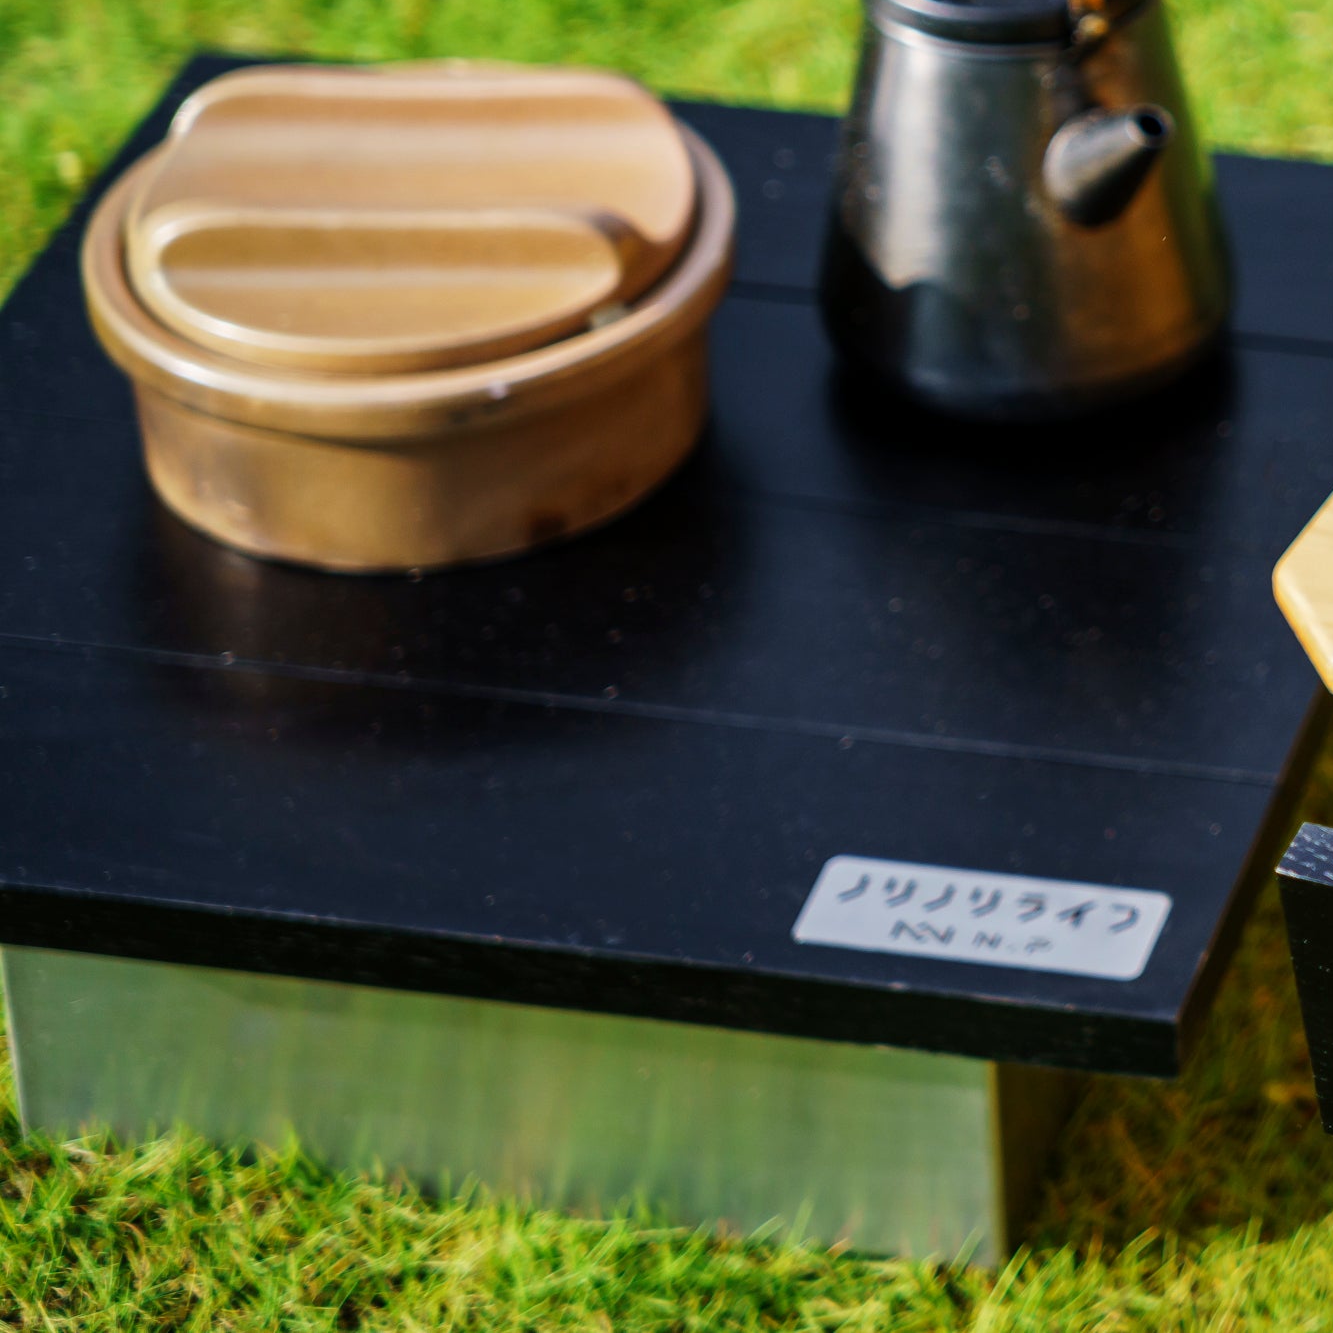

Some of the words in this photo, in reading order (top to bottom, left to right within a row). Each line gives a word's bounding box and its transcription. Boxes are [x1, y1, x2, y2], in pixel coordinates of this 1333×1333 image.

[838, 873, 1140, 932] ノリノリライフ
